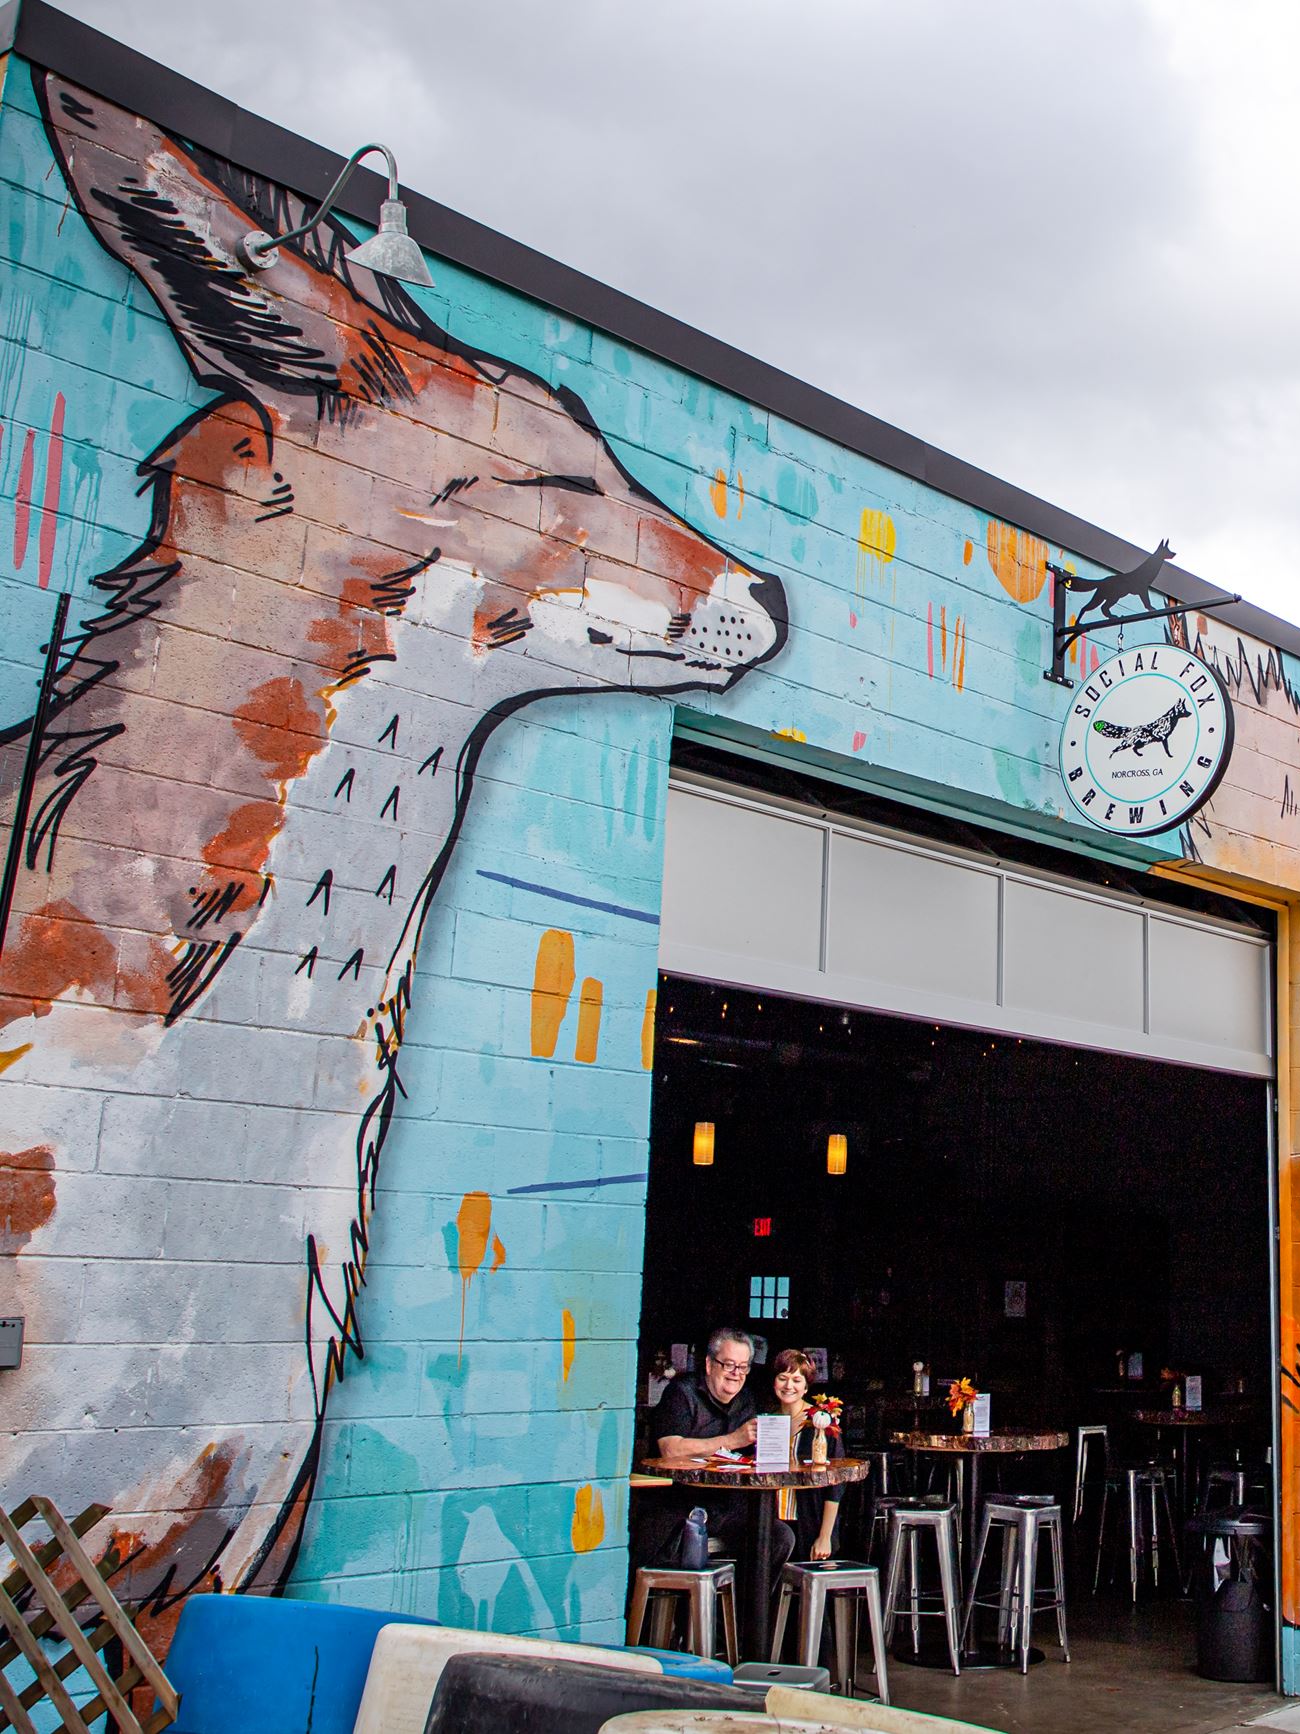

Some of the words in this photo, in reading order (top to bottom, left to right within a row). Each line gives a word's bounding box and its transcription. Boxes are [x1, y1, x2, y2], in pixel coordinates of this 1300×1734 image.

[1075, 651, 1158, 719] SOCIAL
[1179, 661, 1215, 708] FOX
[1068, 755, 1213, 824] BREWING
[1152, 768, 1163, 776] GA
